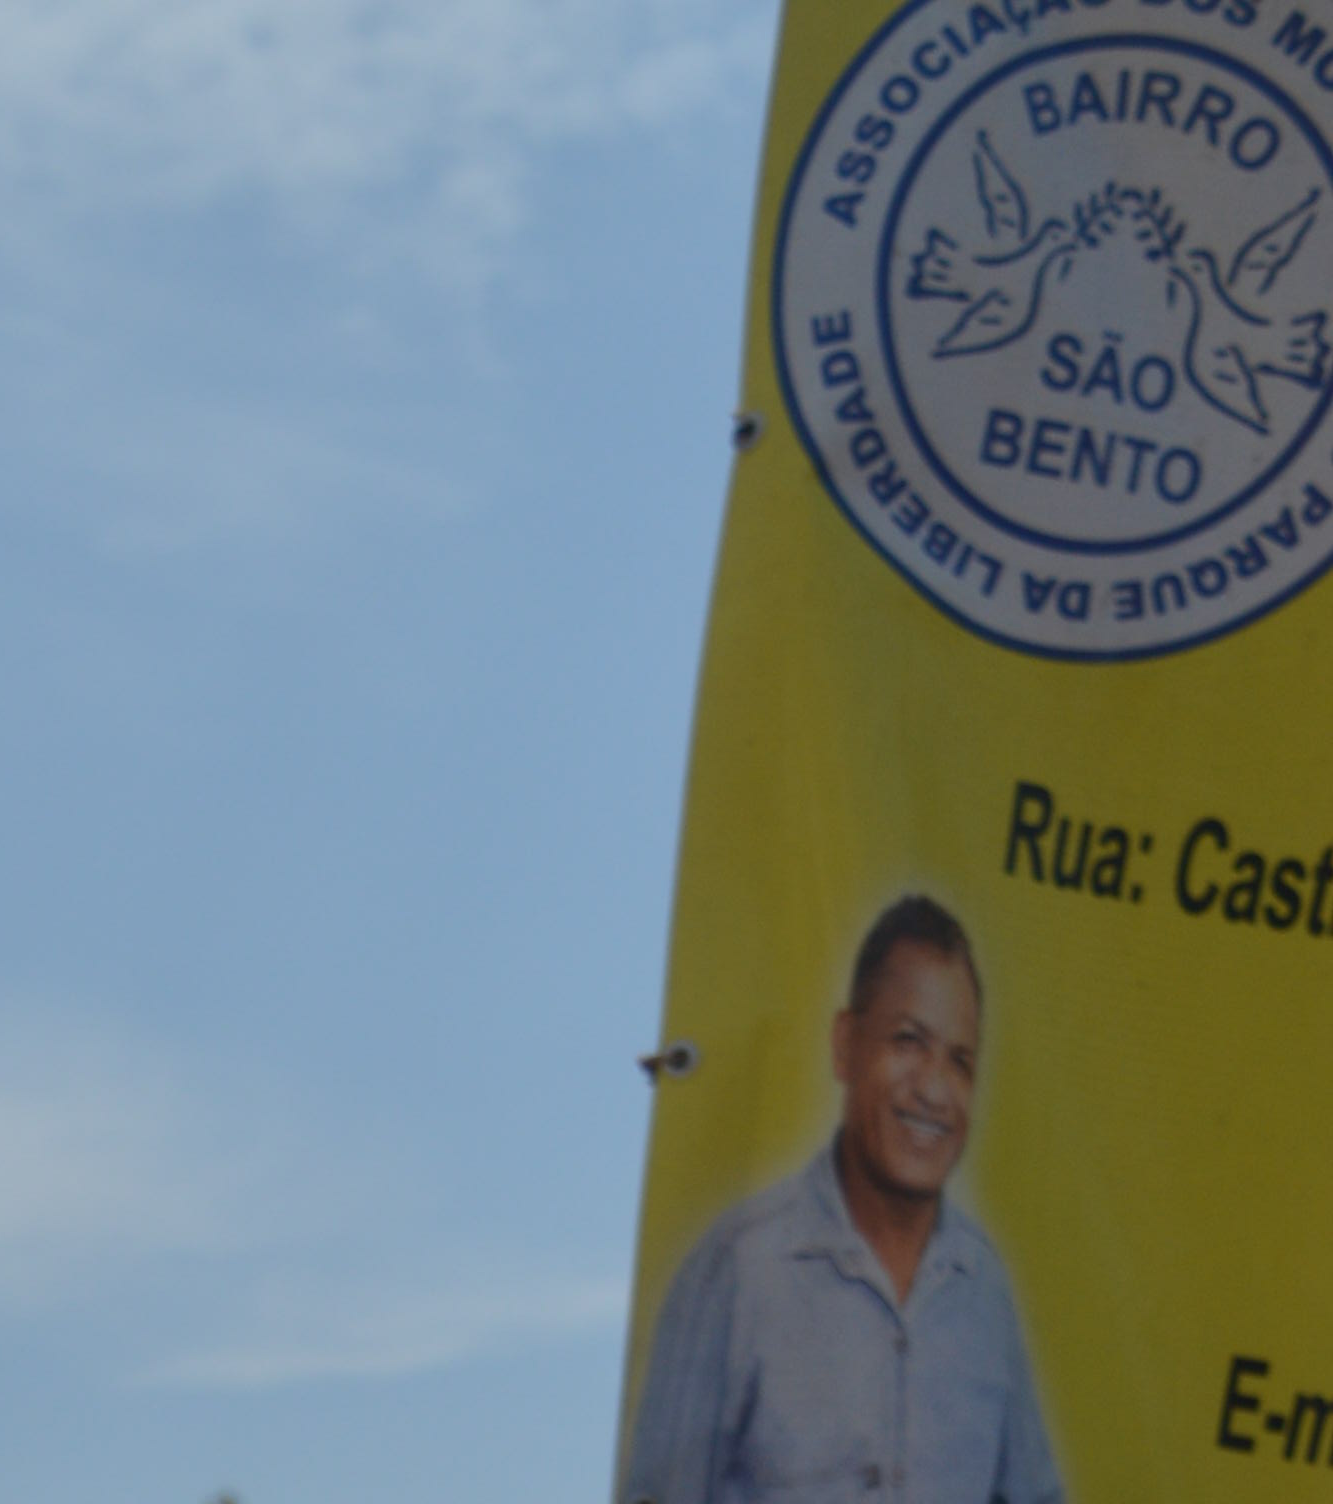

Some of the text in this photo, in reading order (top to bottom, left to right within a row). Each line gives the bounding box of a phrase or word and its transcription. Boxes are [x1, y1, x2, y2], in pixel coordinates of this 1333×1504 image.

[821, 0, 1110, 230] ASSOCIAÇ
[1023, 66, 1280, 171] BAIRRO
[1039, 329, 1176, 413] SÃO
[810, 310, 1333, 622] PARQUE DA LIBERDADE
[979, 408, 1202, 505] BENTO
[1004, 780, 1152, 903] Rua:
